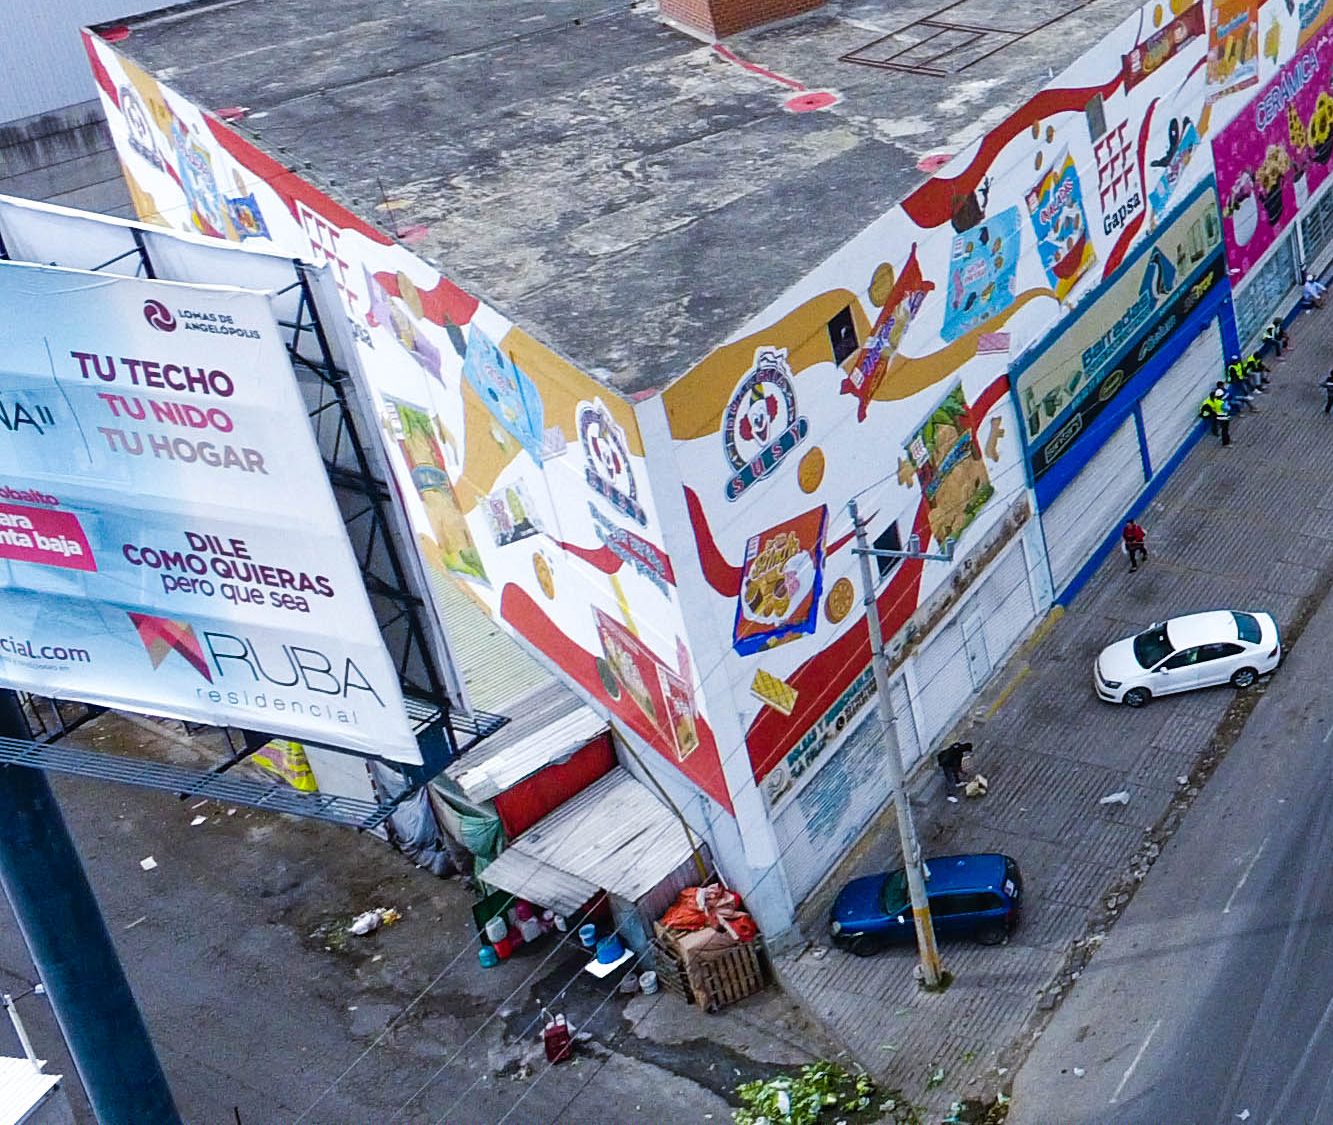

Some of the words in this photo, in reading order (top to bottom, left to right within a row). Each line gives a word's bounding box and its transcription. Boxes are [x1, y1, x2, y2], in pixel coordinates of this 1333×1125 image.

[1102, 192, 1142, 236] Gapsa
[177, 308, 216, 323] LOMAS
[217, 314, 234, 325] DE
[71, 351, 117, 382] TU
[120, 357, 235, 397] TECHO
[97, 392, 146, 420] TU
[148, 399, 234, 433] NIDO
[97, 426, 144, 456] TU
[148, 433, 269, 475] HOGAR
[35, 532, 83, 558] baja
[184, 530, 252, 561] DILE
[122, 543, 208, 575] COMO
[211, 558, 335, 598] QUIERAS
[161, 573, 216, 596] pero
[221, 585, 265, 609] que
[270, 591, 311, 613] sea
[203, 630, 386, 708] RUBA
[196, 685, 358, 725] residencial
